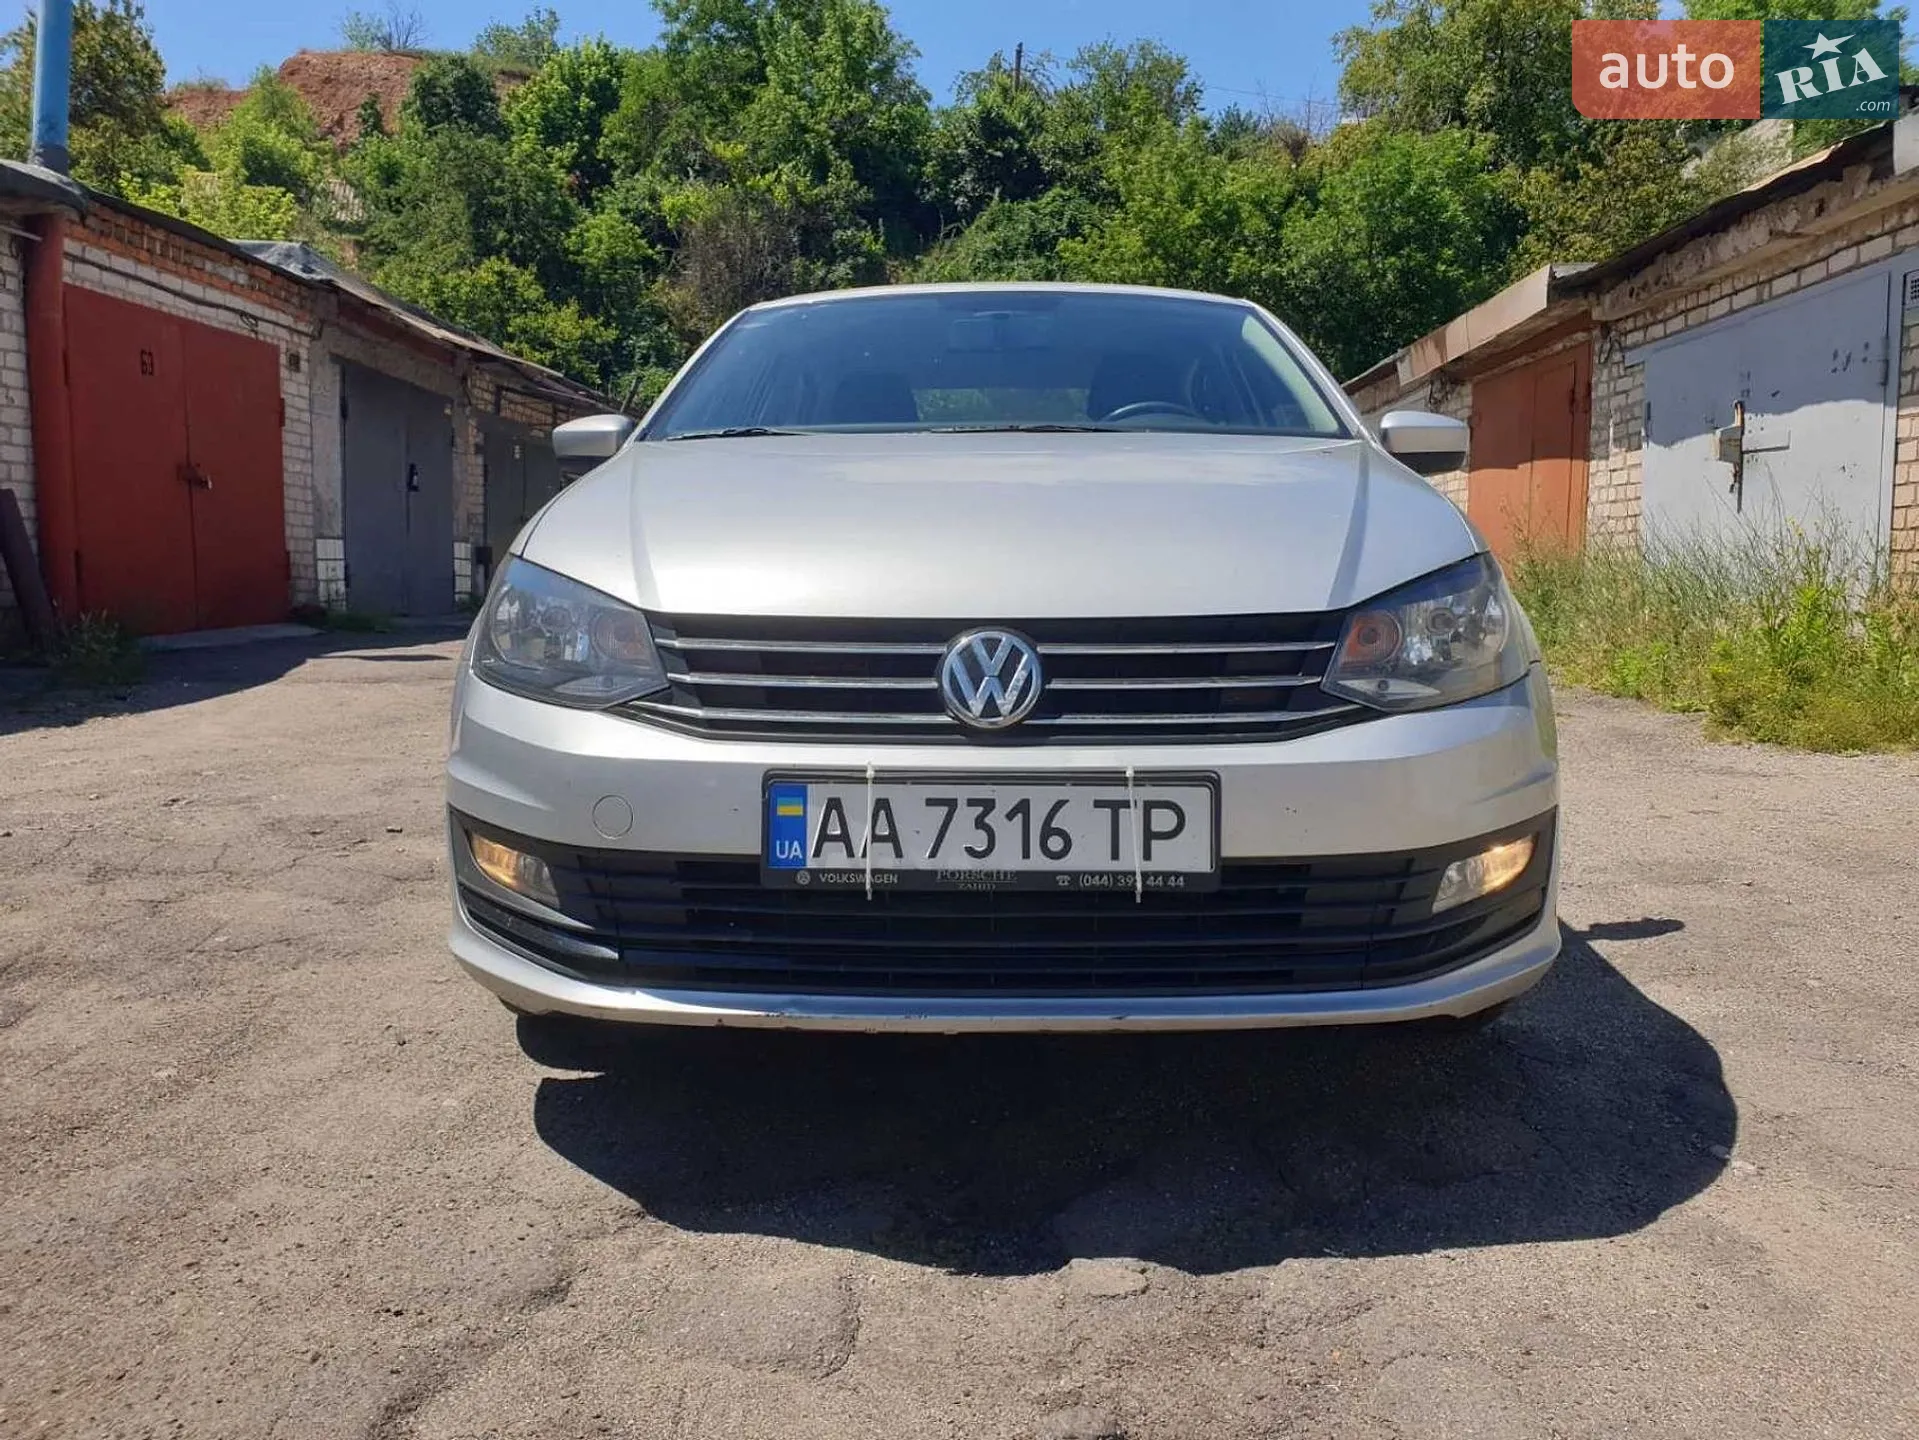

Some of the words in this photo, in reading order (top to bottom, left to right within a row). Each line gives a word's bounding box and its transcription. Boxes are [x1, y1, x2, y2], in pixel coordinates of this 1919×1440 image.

[811, 797, 903, 858] AA
[924, 797, 1073, 861] 7316
[1093, 799, 1186, 861] TP
[776, 840, 803, 860] UA
[1080, 873, 1113, 887] (044)
[1117, 875, 1141, 887] 39
[1146, 875, 1163, 887] 44
[1167, 875, 1184, 887] 44
